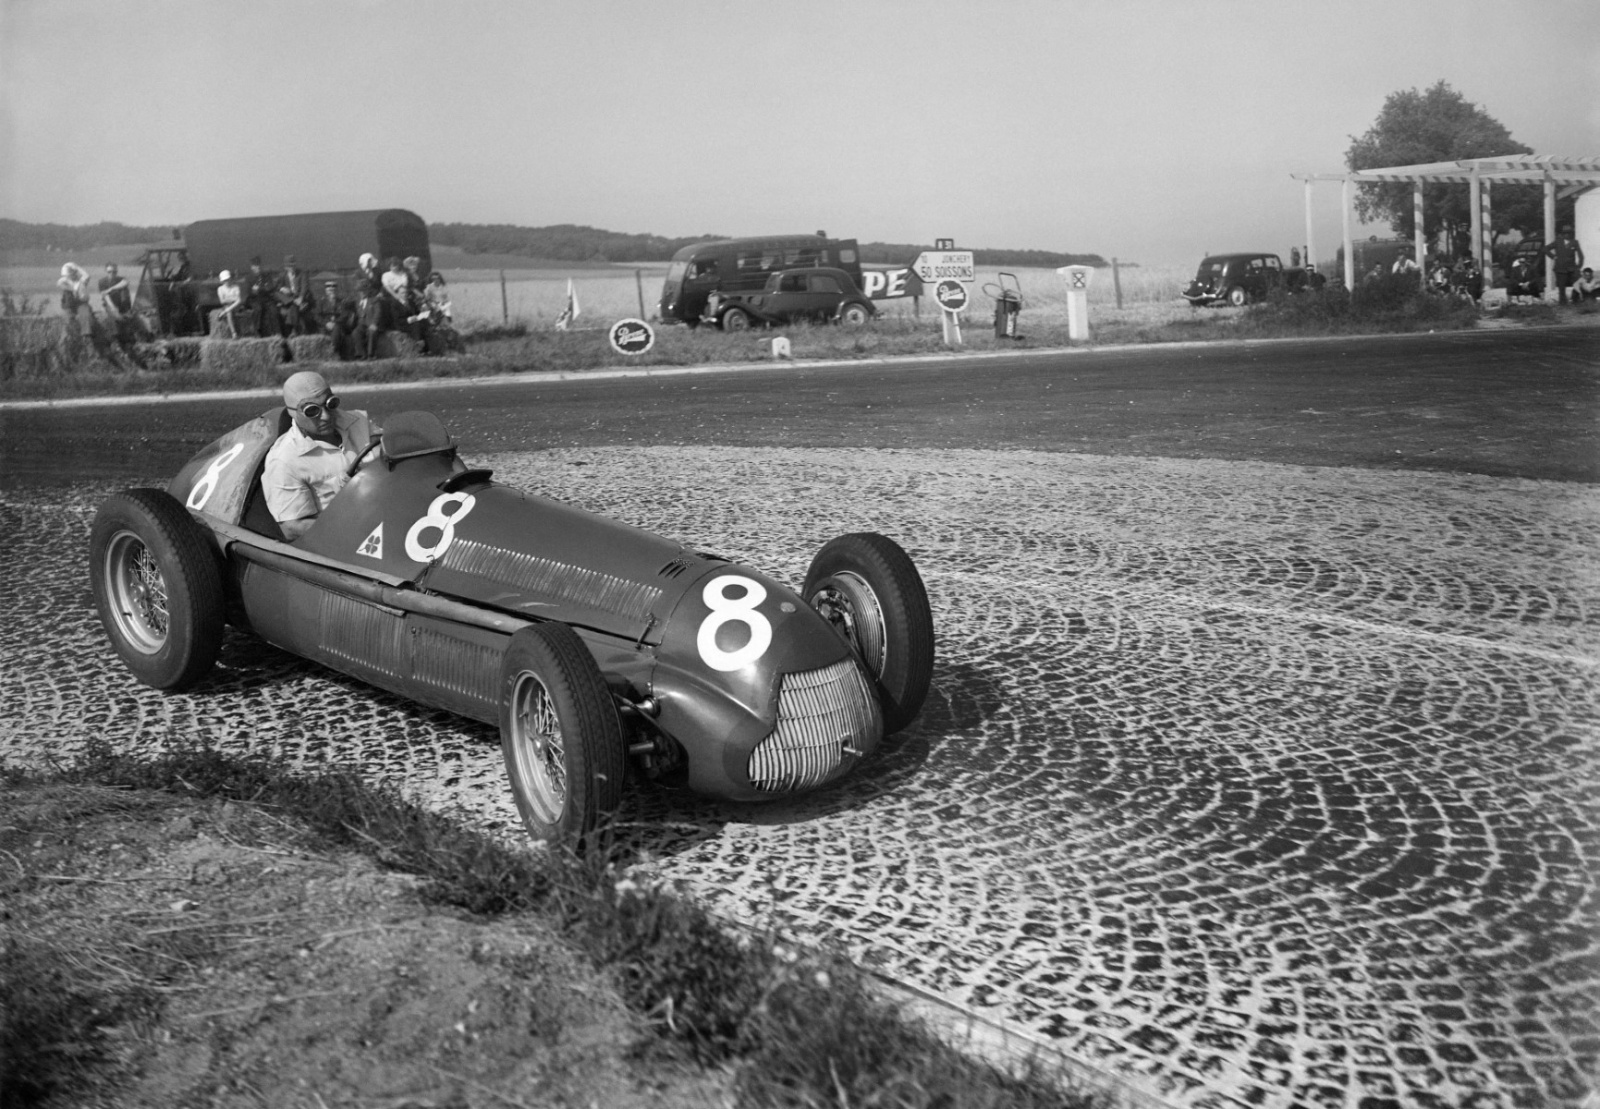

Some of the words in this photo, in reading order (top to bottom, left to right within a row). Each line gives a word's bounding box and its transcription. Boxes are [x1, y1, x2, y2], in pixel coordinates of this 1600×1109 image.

[921, 266, 932, 278] 50
[935, 265, 973, 278] SOISSONS
[185, 443, 245, 511] 8
[404, 491, 477, 564] 8
[696, 574, 773, 672] 8
